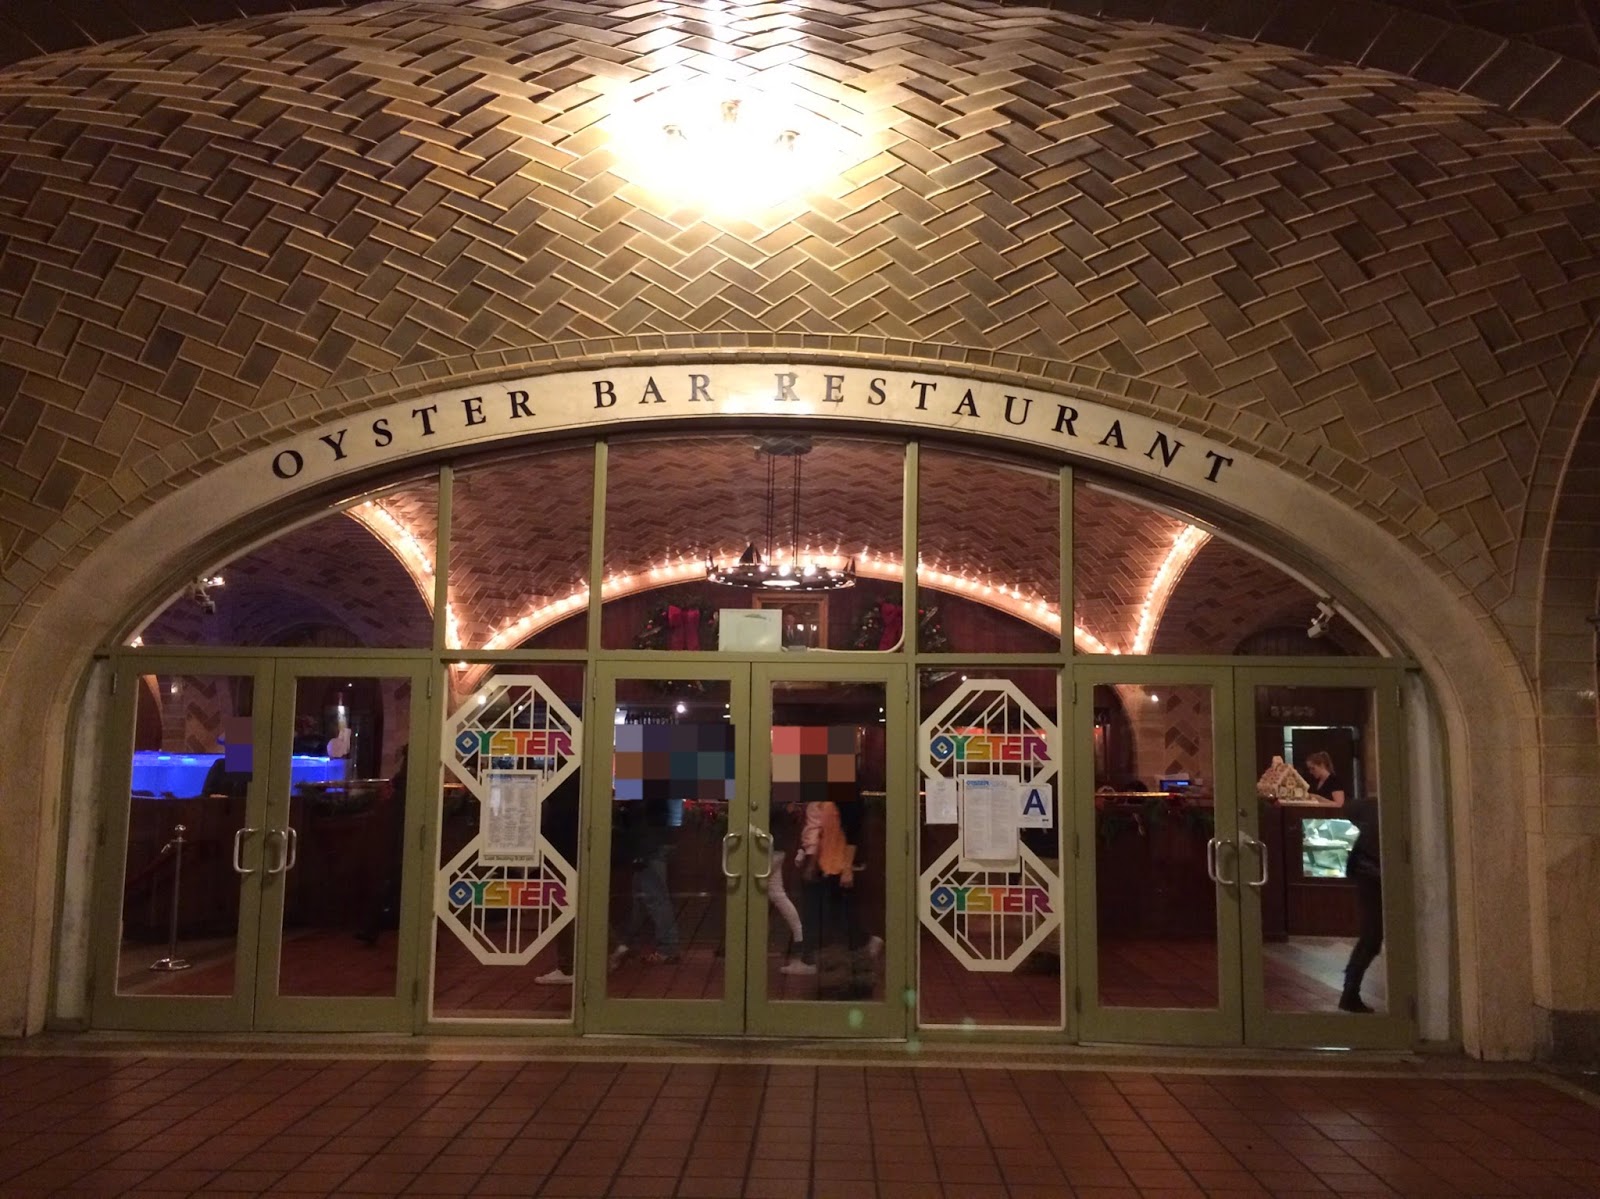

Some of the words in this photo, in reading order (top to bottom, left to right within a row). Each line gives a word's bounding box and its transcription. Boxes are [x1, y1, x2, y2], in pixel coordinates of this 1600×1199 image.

[272, 389, 536, 480] OYSTER
[592, 373, 715, 409] BAR
[774, 372, 1234, 484] RESTAURANT
[455, 730, 575, 756] OYSTER
[930, 735, 1052, 761] OYSTER
[1023, 788, 1046, 815] A
[448, 880, 569, 908] OYSTER
[930, 886, 1054, 914] OYSTER
